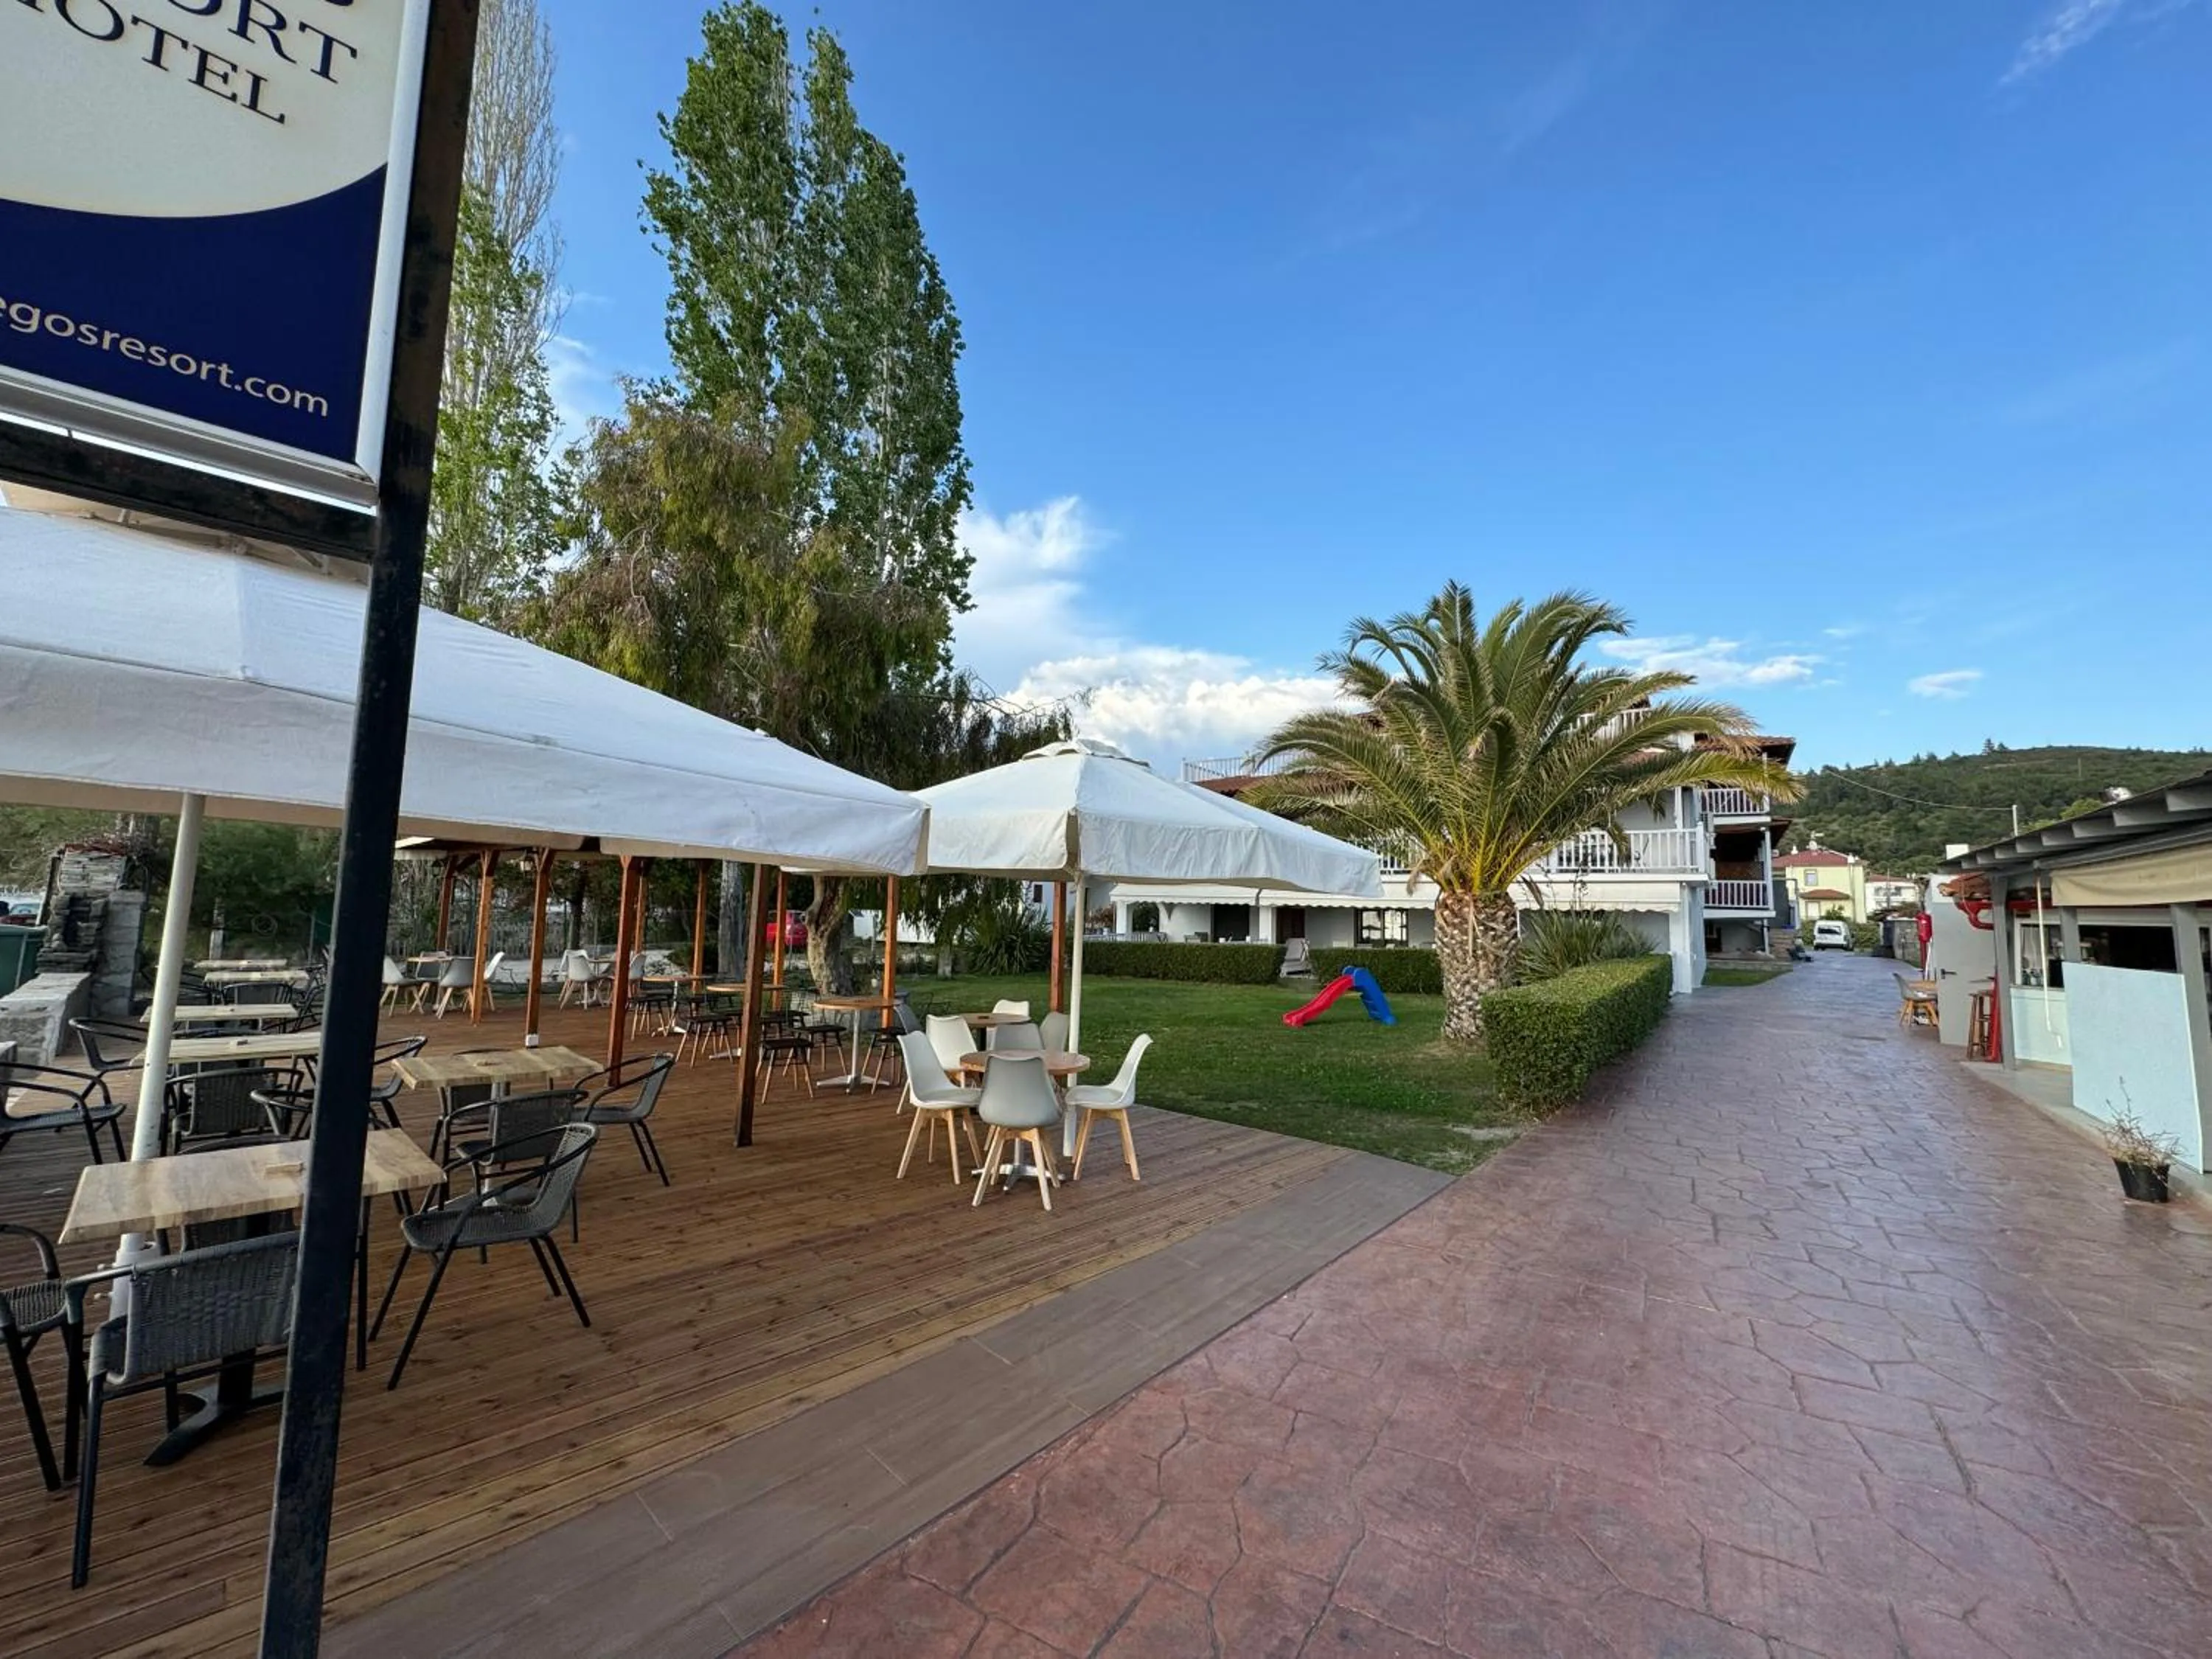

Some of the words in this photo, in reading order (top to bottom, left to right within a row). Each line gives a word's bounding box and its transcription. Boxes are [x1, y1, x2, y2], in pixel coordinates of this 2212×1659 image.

[16, 0, 285, 125] OTEL
[167, 0, 358, 84] RT
[0, 296, 329, 417] gosresort.com
